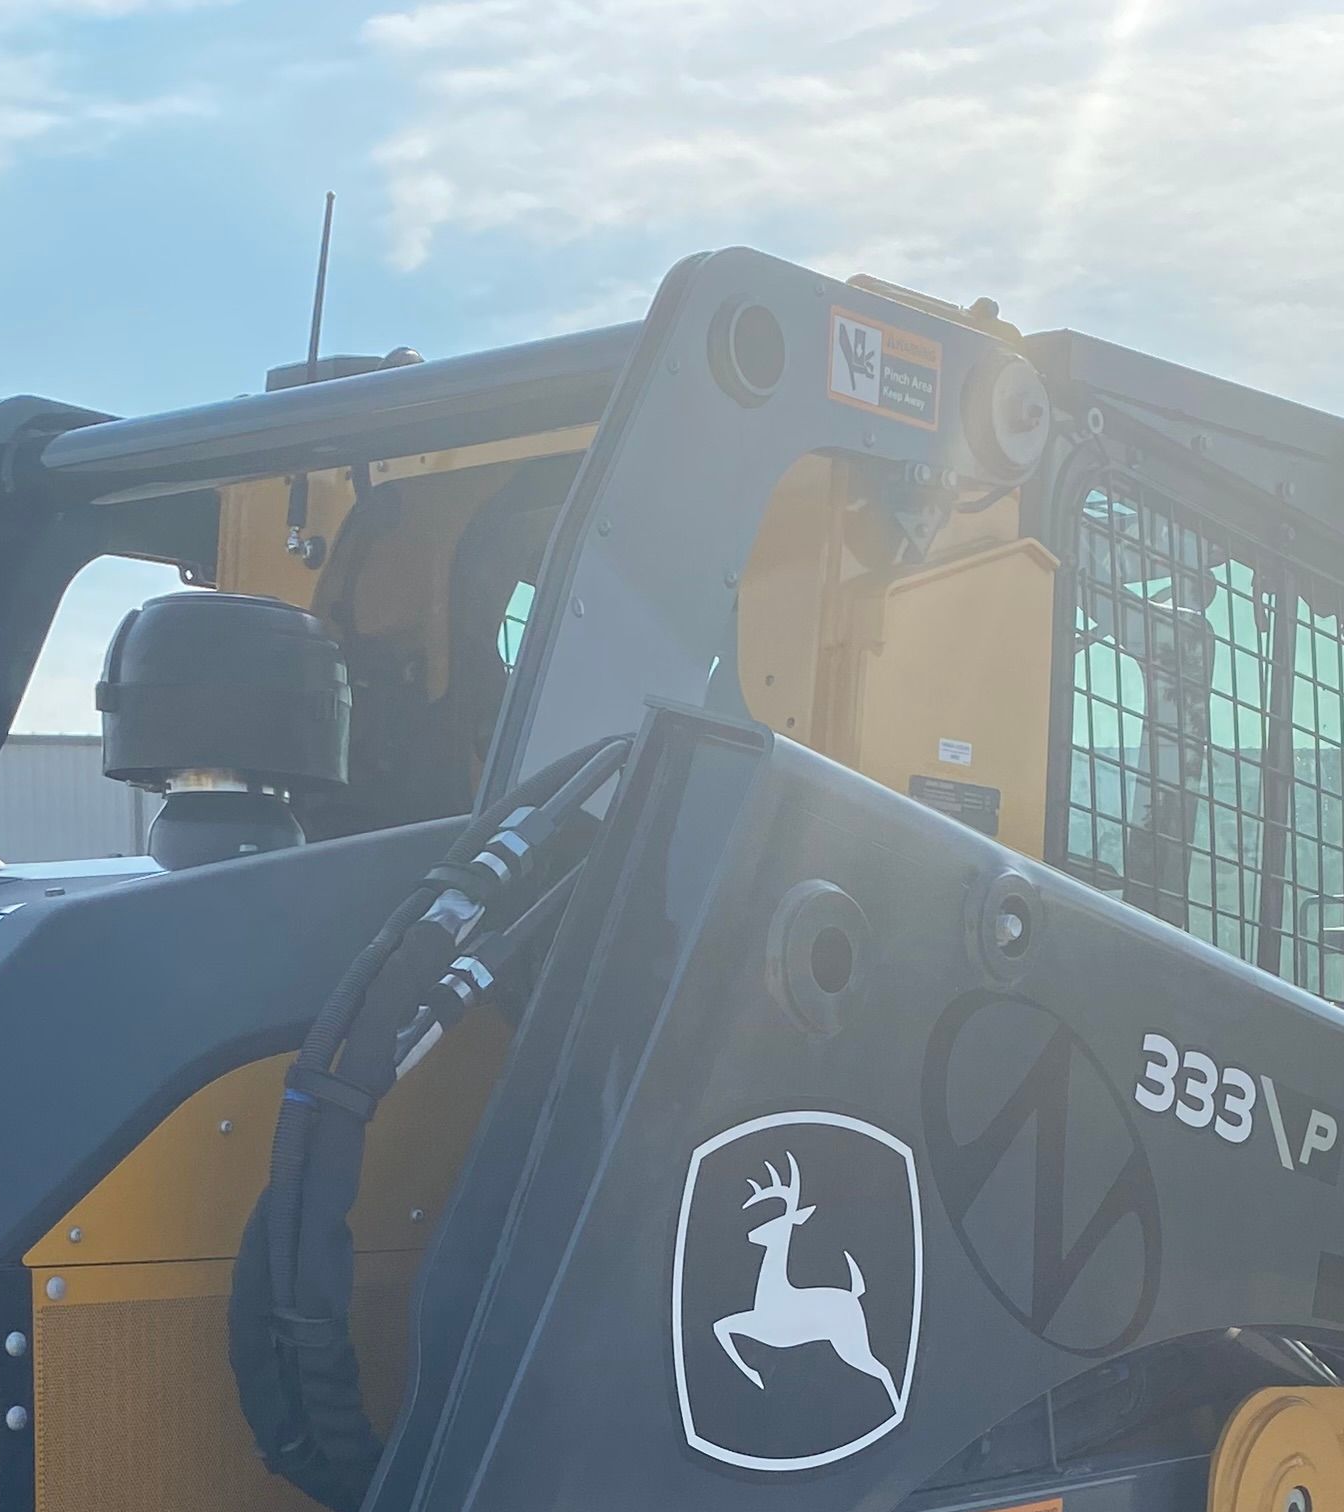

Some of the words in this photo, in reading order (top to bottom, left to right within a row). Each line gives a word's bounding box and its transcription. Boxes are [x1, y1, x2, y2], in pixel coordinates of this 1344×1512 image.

[884, 366, 910, 386] Pinch
[911, 376, 933, 393] Area
[882, 386, 903, 402] Keep
[903, 392, 926, 411] Away
